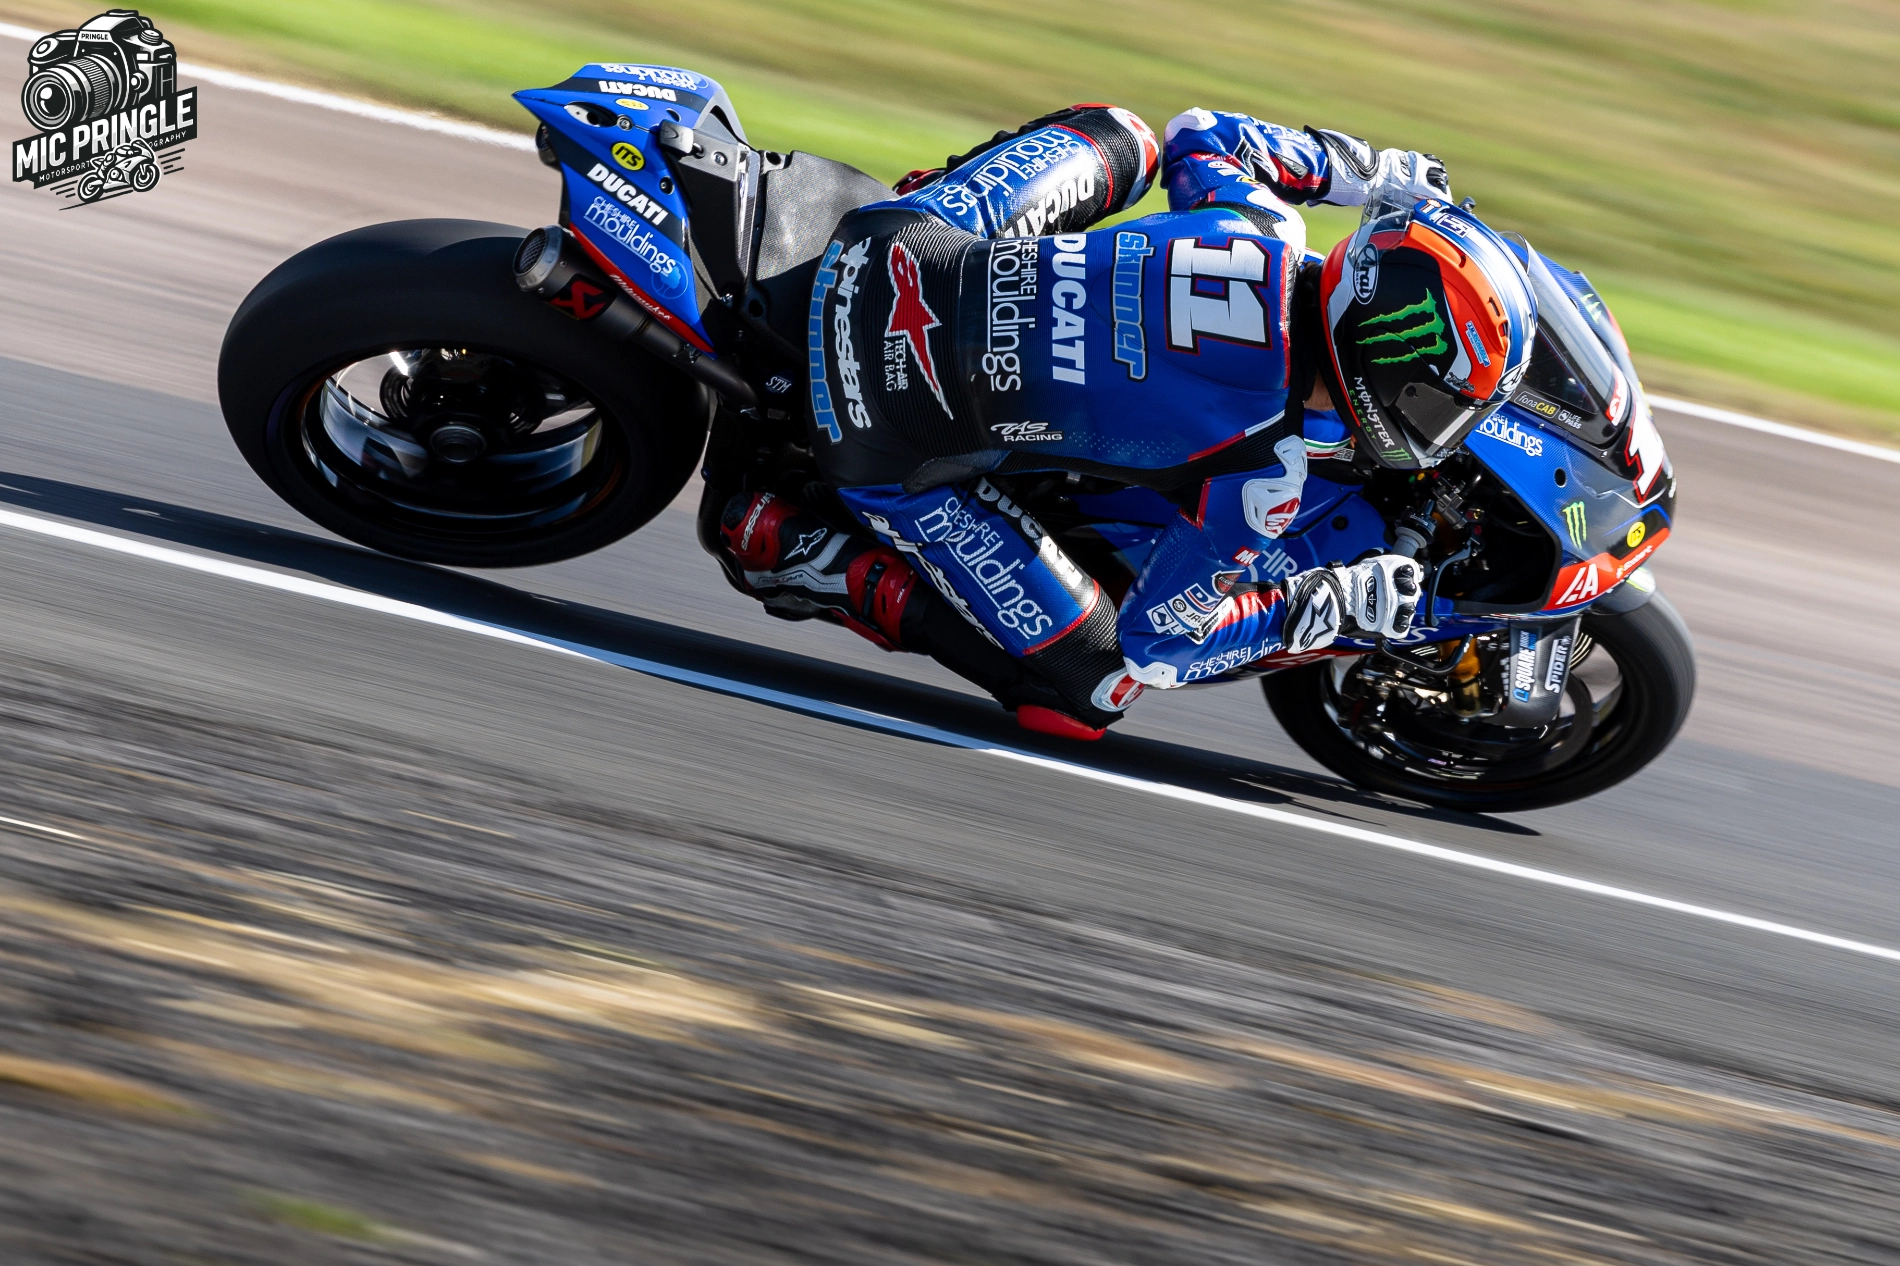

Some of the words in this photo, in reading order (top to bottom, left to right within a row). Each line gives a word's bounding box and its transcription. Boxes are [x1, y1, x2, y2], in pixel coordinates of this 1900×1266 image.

[599, 81, 677, 102] DUCATI
[614, 145, 641, 168] ITS
[937, 129, 1073, 216] mouldings
[1020, 140, 1084, 181] CHESHIRE
[587, 164, 669, 225] DUCATI
[593, 196, 637, 231] CHESHIRE
[585, 203, 676, 275] mouldings
[1021, 237, 1038, 294] HESHIRE
[1358, 247, 1377, 296] Arai
[1052, 233, 1087, 386] DUCATI
[1113, 232, 1155, 380] skinner
[1168, 237, 1269, 352] 11
[808, 239, 844, 444] skinner
[834, 237, 872, 429] alpinestars
[883, 340, 895, 361] AIR
[765, 376, 792, 393] STM
[885, 364, 898, 393] BAG
[1518, 394, 1557, 415] fonaCAB
[1004, 431, 1064, 442] RACING
[1349, 389, 1377, 440] ENERGY
[1354, 377, 1395, 448] MONSTER
[1478, 417, 1543, 457] ouldings
[975, 477, 1083, 589] DUCATI
[919, 506, 1053, 640] mouldings
[1515, 648, 1536, 690] SQUARE
[1545, 639, 1568, 693] SPIDER
